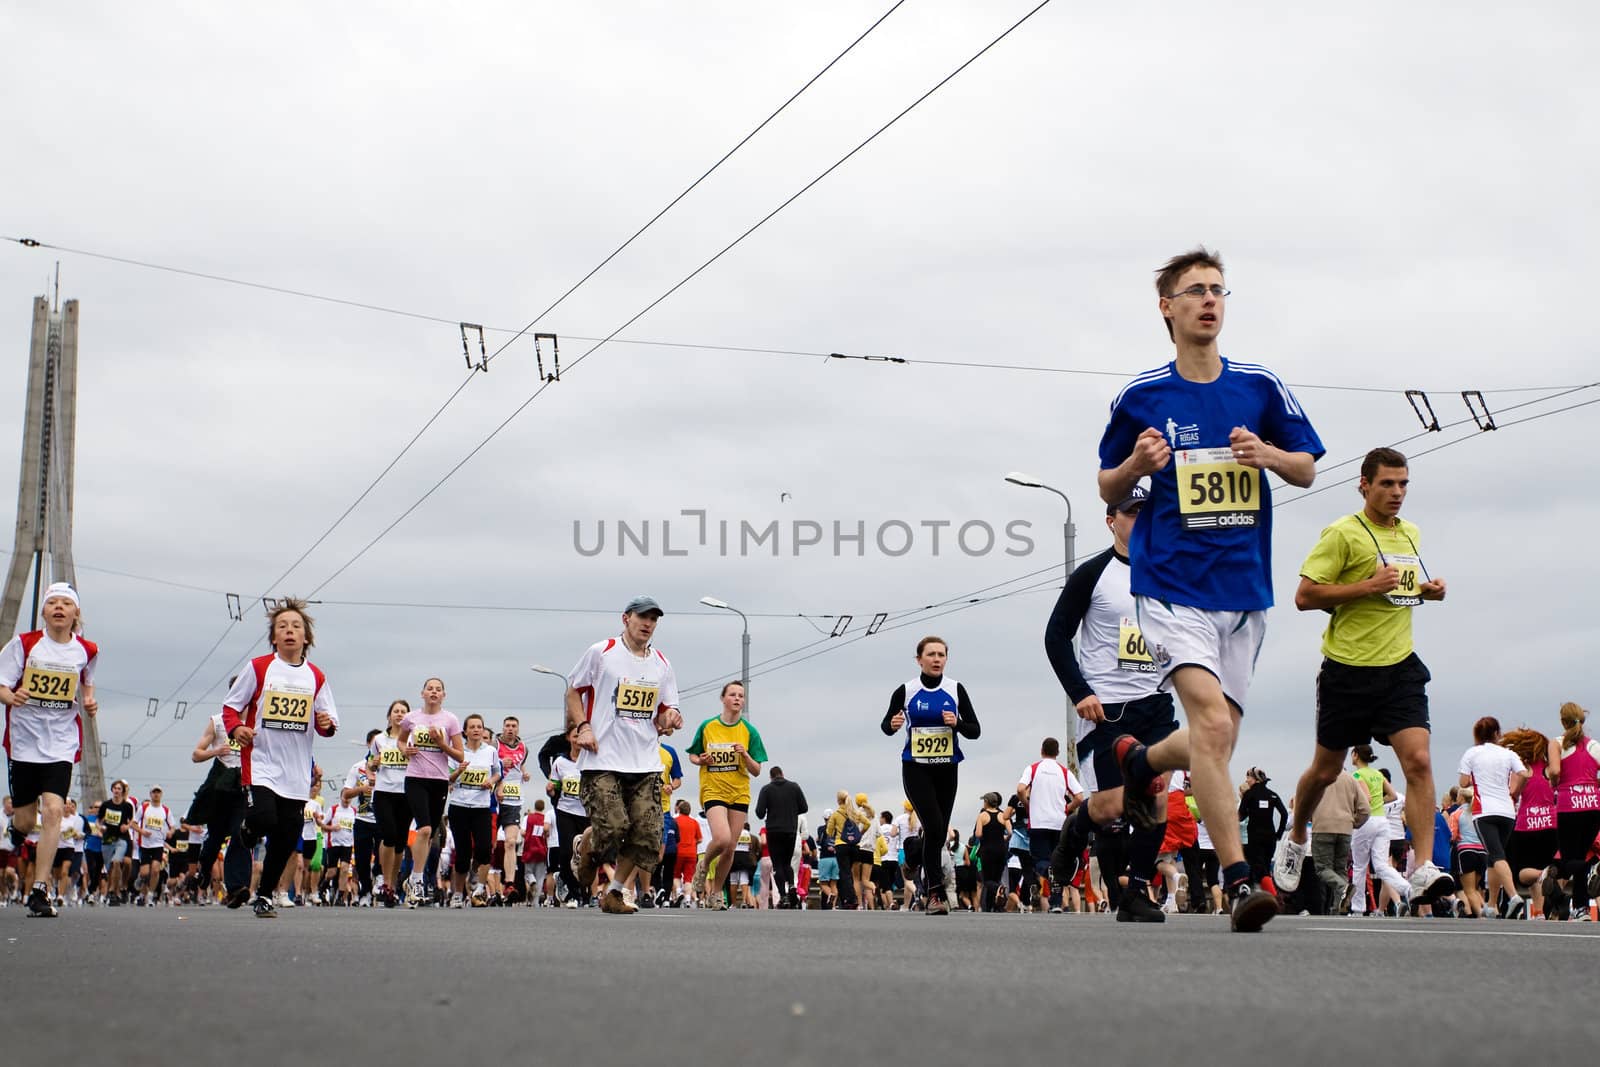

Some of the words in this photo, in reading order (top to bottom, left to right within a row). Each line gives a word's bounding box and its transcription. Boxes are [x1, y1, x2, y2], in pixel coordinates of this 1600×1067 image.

[1190, 470, 1252, 506] 5810
[1218, 513, 1255, 526] adidas
[1397, 570, 1415, 591] 48
[1394, 597, 1420, 606] adidas
[1126, 633, 1151, 656] 60
[28, 673, 71, 696] 5324
[41, 700, 68, 709] adidas
[622, 689, 654, 708] 5518
[269, 696, 308, 718] 5323
[282, 722, 306, 731] adidas
[917, 737, 949, 753] 5929
[463, 771, 486, 783] 7247
[502, 784, 519, 794] 6363
[1584, 784, 1595, 793] MY
[1571, 795, 1599, 809] SHAPE
[1540, 806, 1550, 815] MY
[1527, 816, 1552, 829] SHAPE
